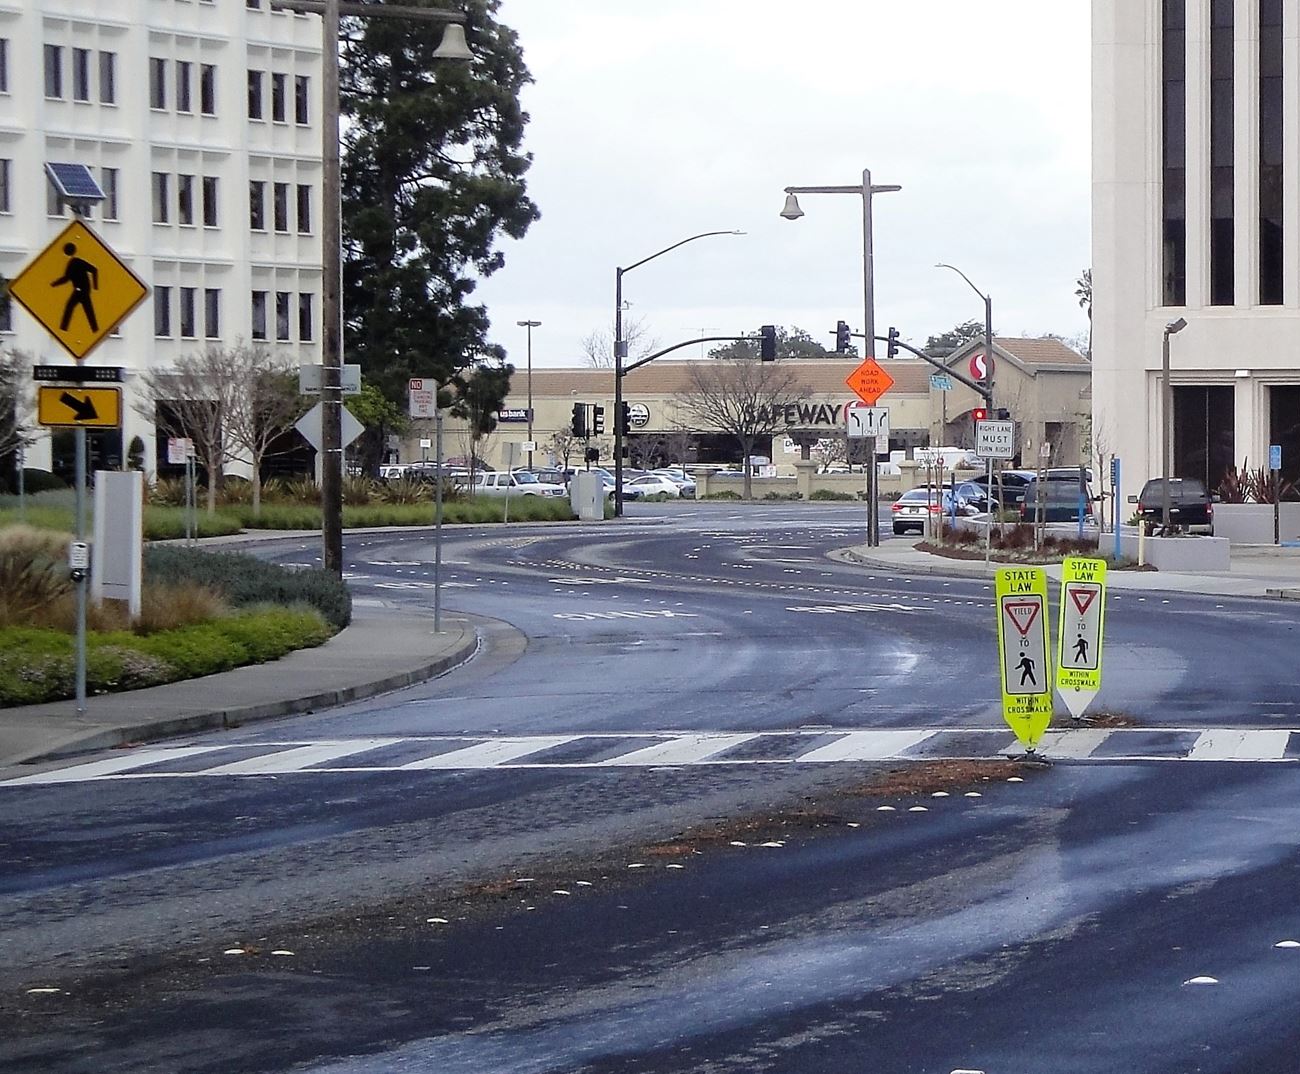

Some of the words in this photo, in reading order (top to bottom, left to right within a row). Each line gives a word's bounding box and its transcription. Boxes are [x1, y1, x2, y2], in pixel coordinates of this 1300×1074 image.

[411, 380, 422, 389] NO
[1071, 561, 1098, 571] STATE
[1005, 571, 1037, 581] STATE
[1075, 572, 1094, 580] LAW
[1010, 583, 1032, 592] LAW
